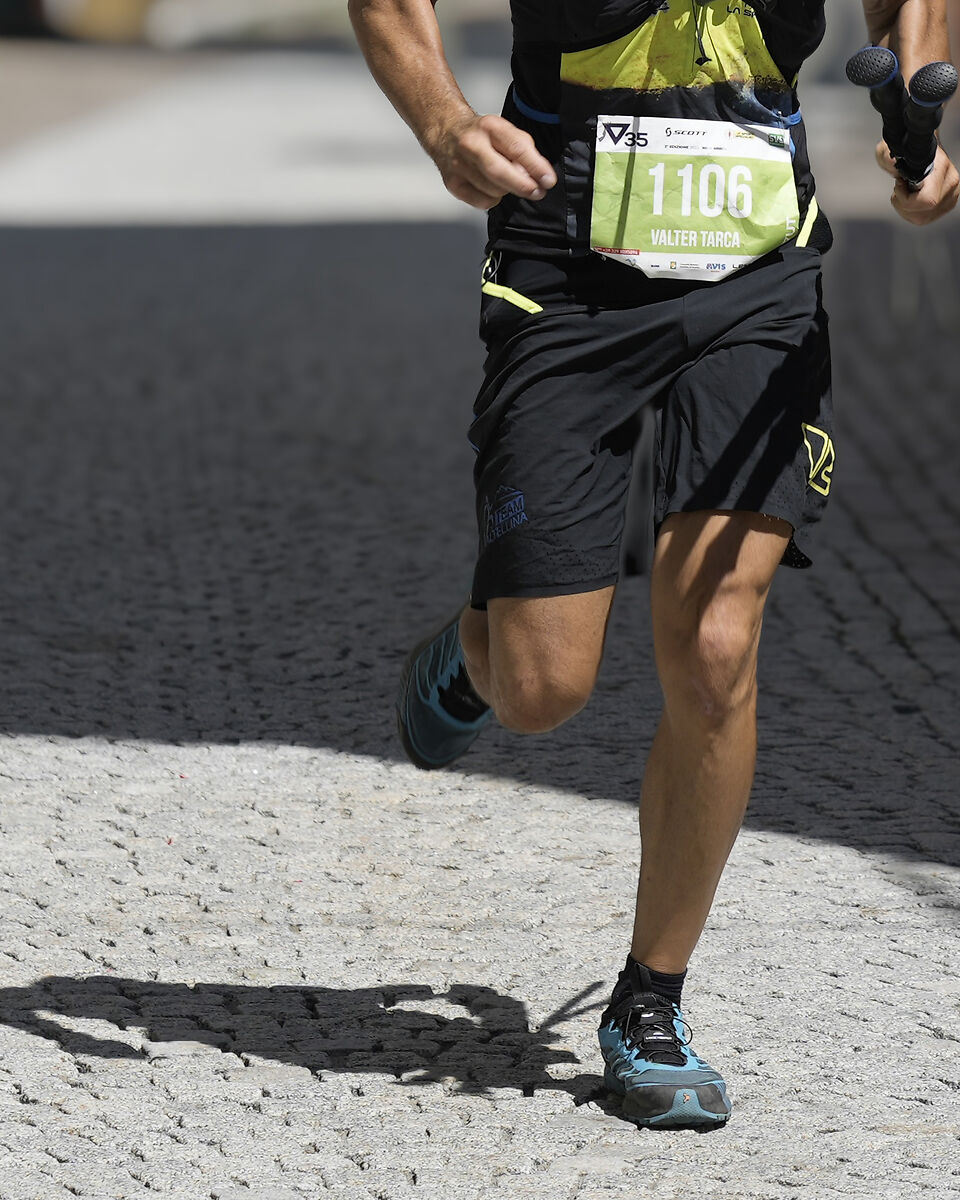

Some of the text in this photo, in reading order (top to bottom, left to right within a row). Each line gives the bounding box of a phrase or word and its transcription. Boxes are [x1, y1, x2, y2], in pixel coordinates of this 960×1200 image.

[624, 131, 649, 147] 35
[648, 162, 753, 219] 1106
[651, 228, 741, 249] VALTER TARCA
[705, 263, 727, 271] AVIS
